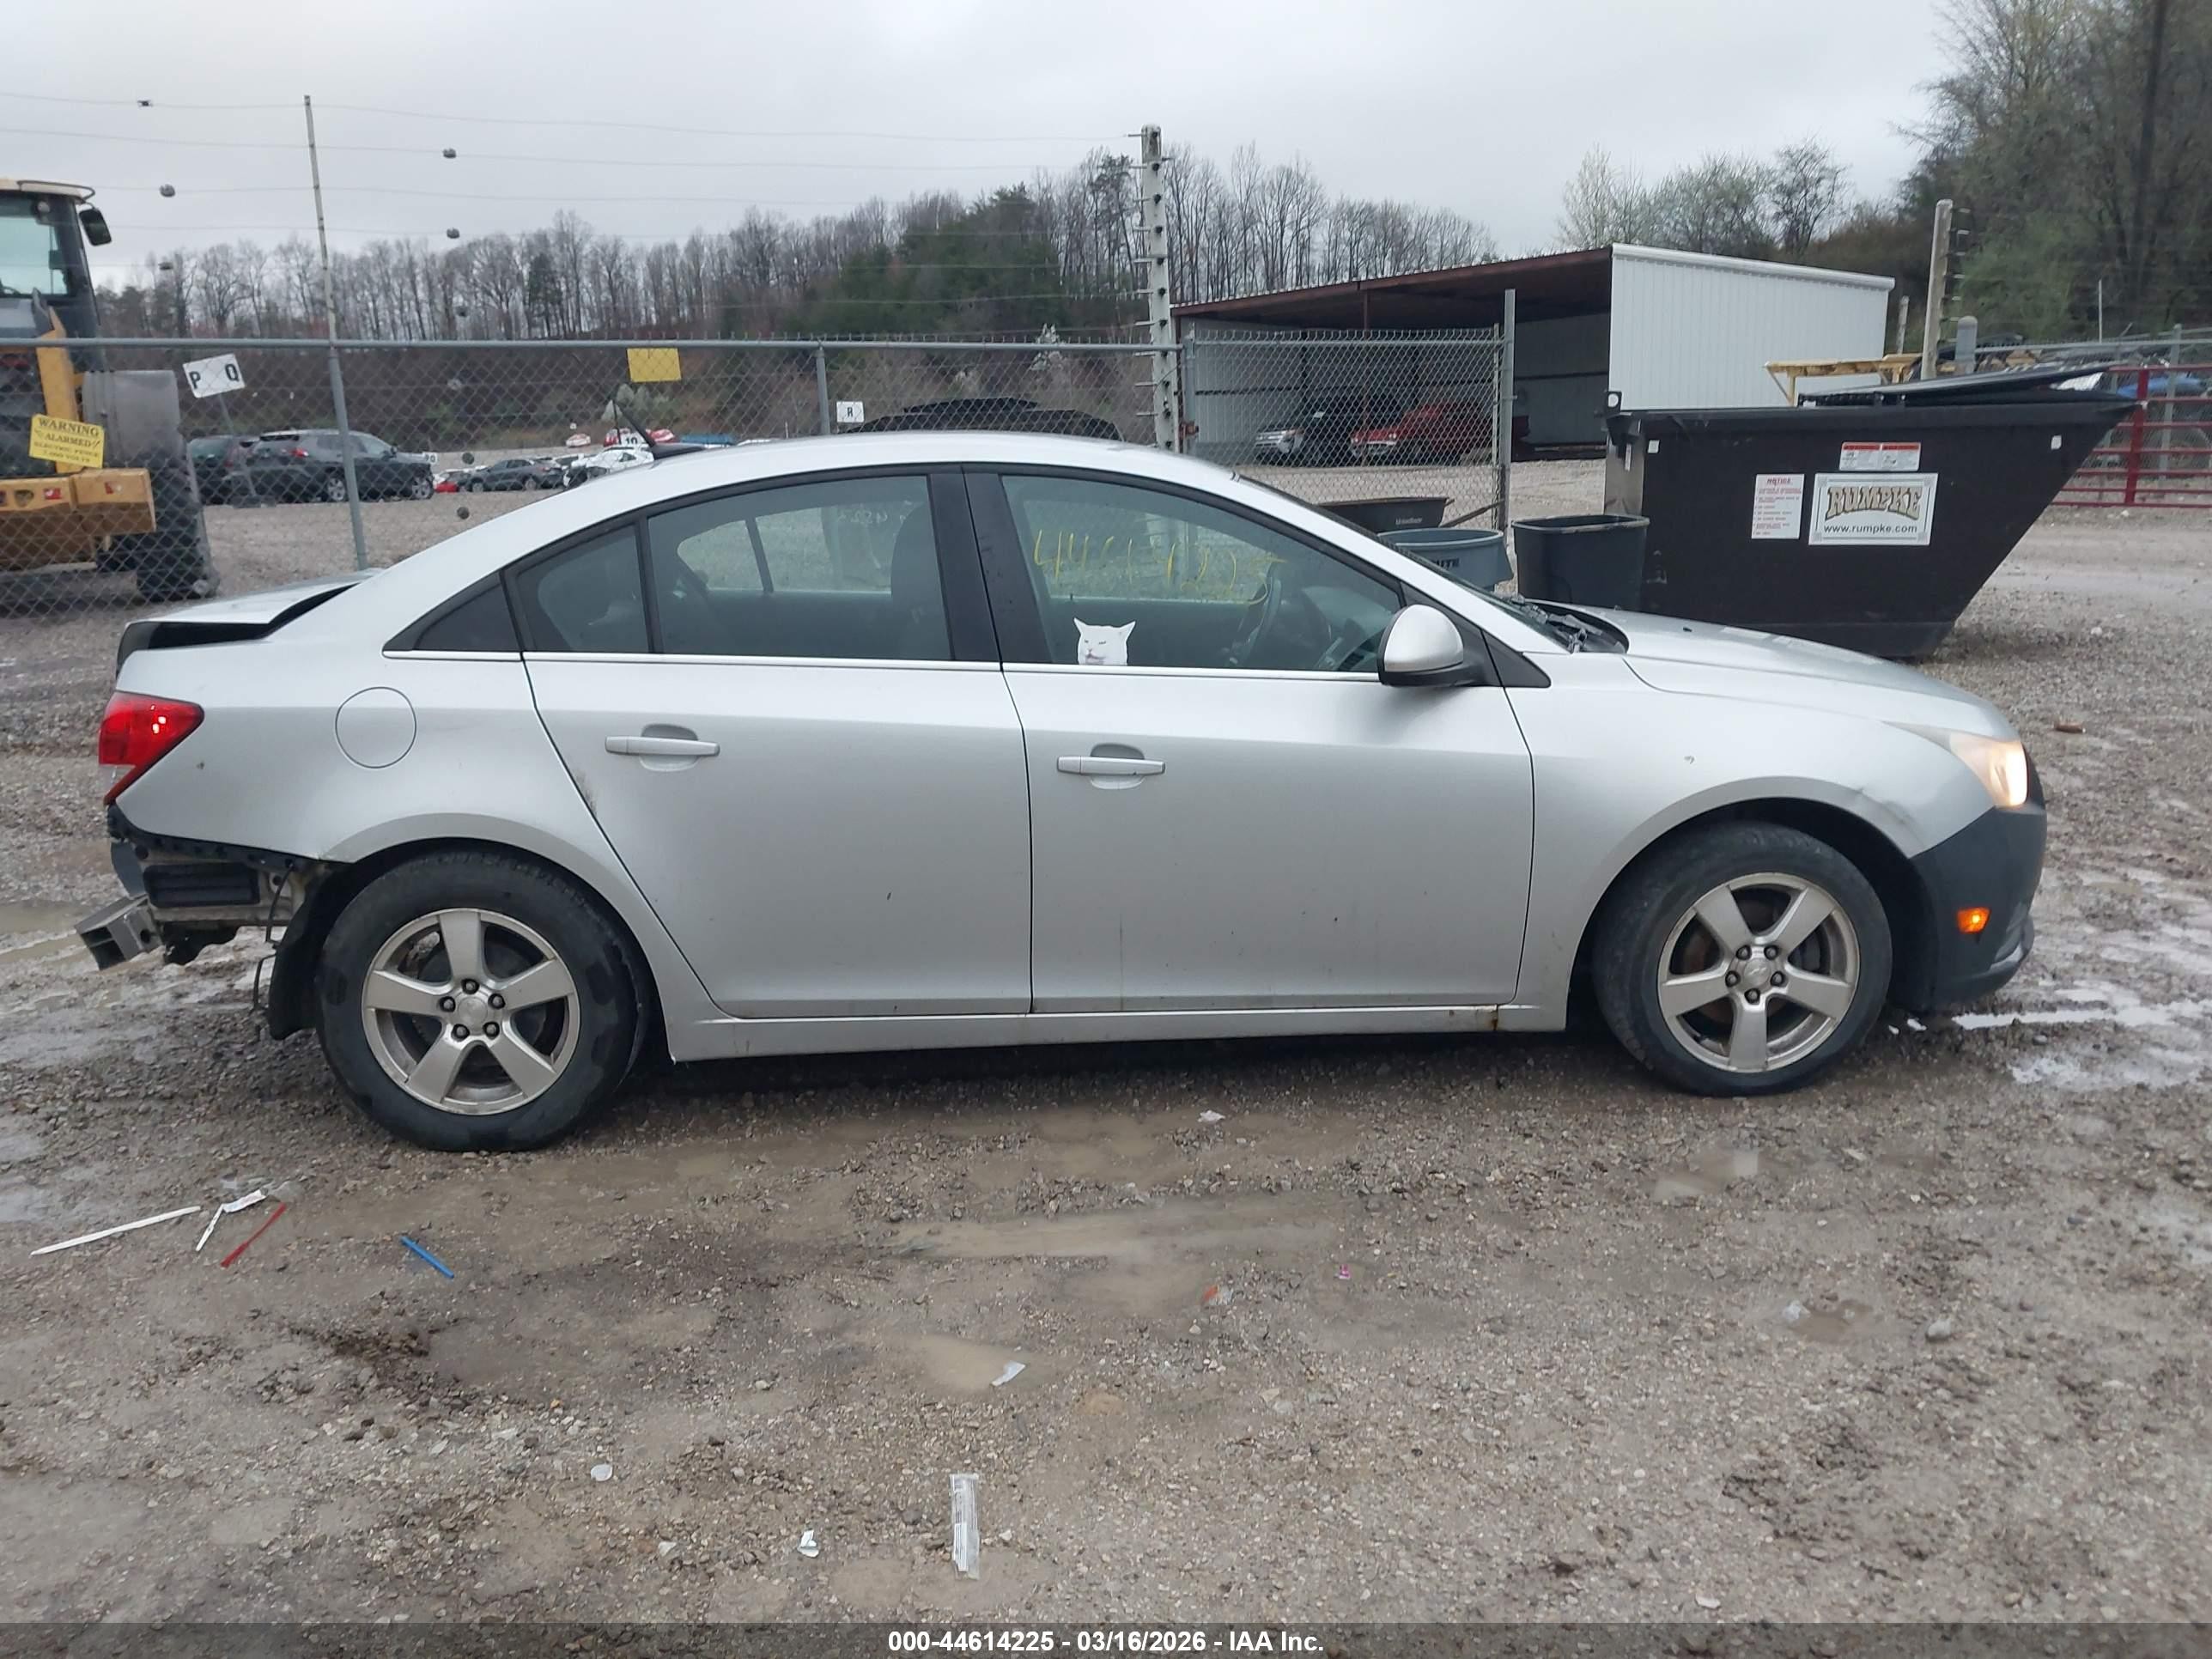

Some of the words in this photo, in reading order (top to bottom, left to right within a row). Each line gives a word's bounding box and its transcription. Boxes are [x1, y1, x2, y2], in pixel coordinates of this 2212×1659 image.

[189, 371, 201, 389] P
[225, 363, 240, 382] Q
[847, 406, 854, 416] R
[39, 417, 99, 436] WARNING
[1825, 486, 1923, 521] RUMPKE
[1824, 524, 1917, 535] www.rumpke.com
